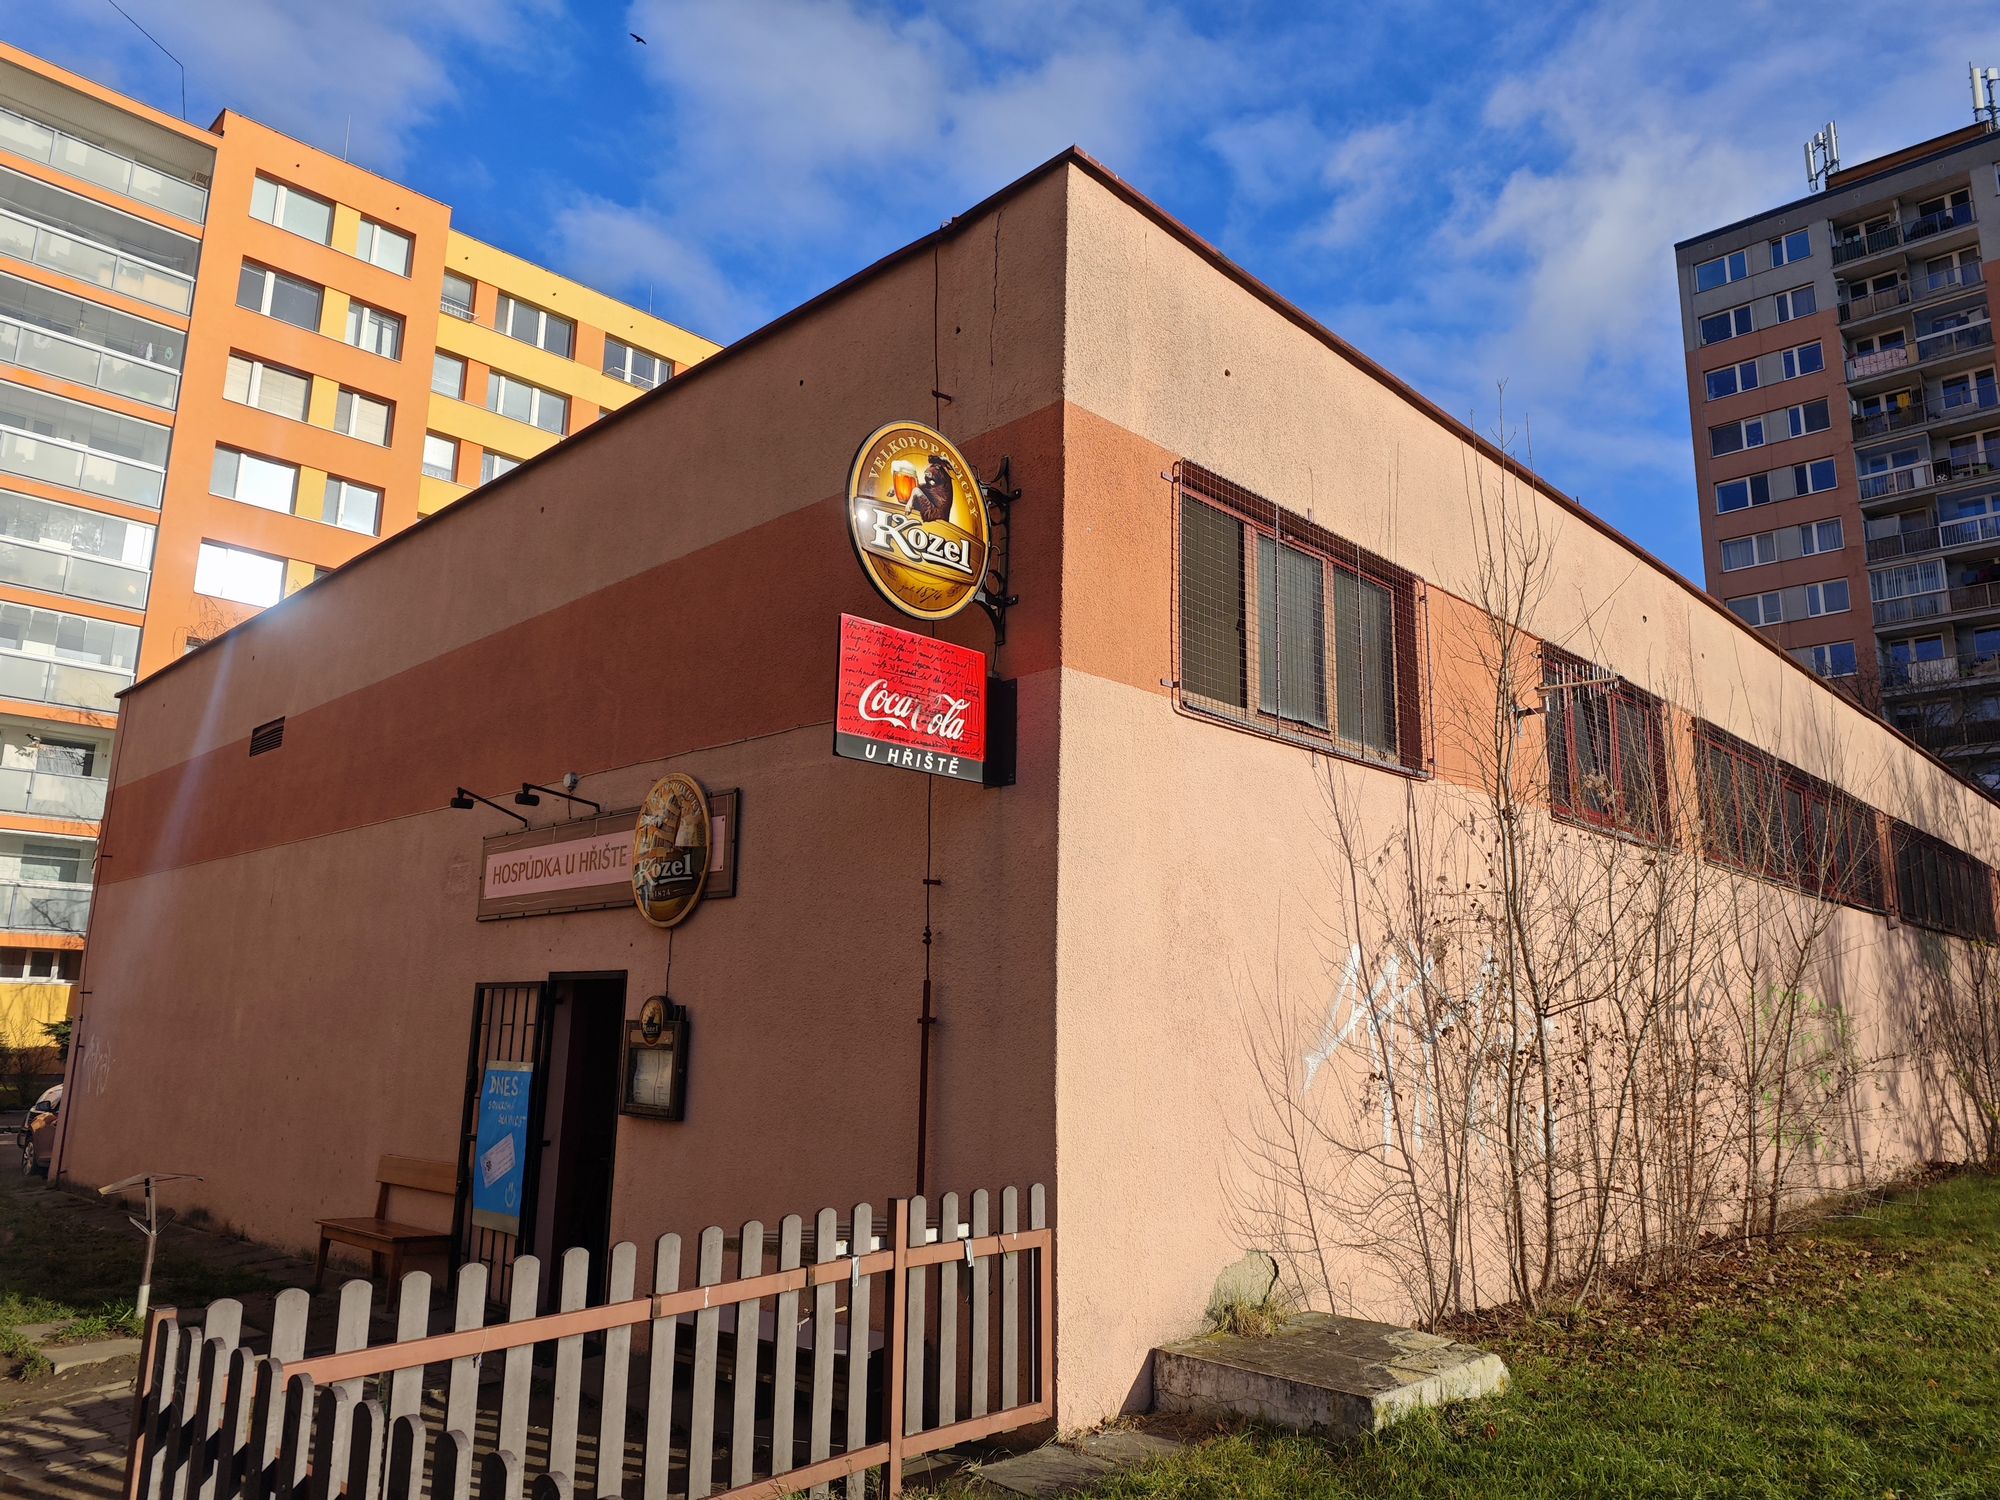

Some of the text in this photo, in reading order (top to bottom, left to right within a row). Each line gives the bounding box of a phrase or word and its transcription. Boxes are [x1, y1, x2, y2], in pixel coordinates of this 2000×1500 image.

[872, 508, 972, 570] Kozel
[858, 678, 971, 740] CocaCola
[865, 743, 877, 758] U
[887, 747, 960, 775] HŘIŠTĚ
[566, 853, 575, 875] U
[634, 853, 693, 887] Kozel
